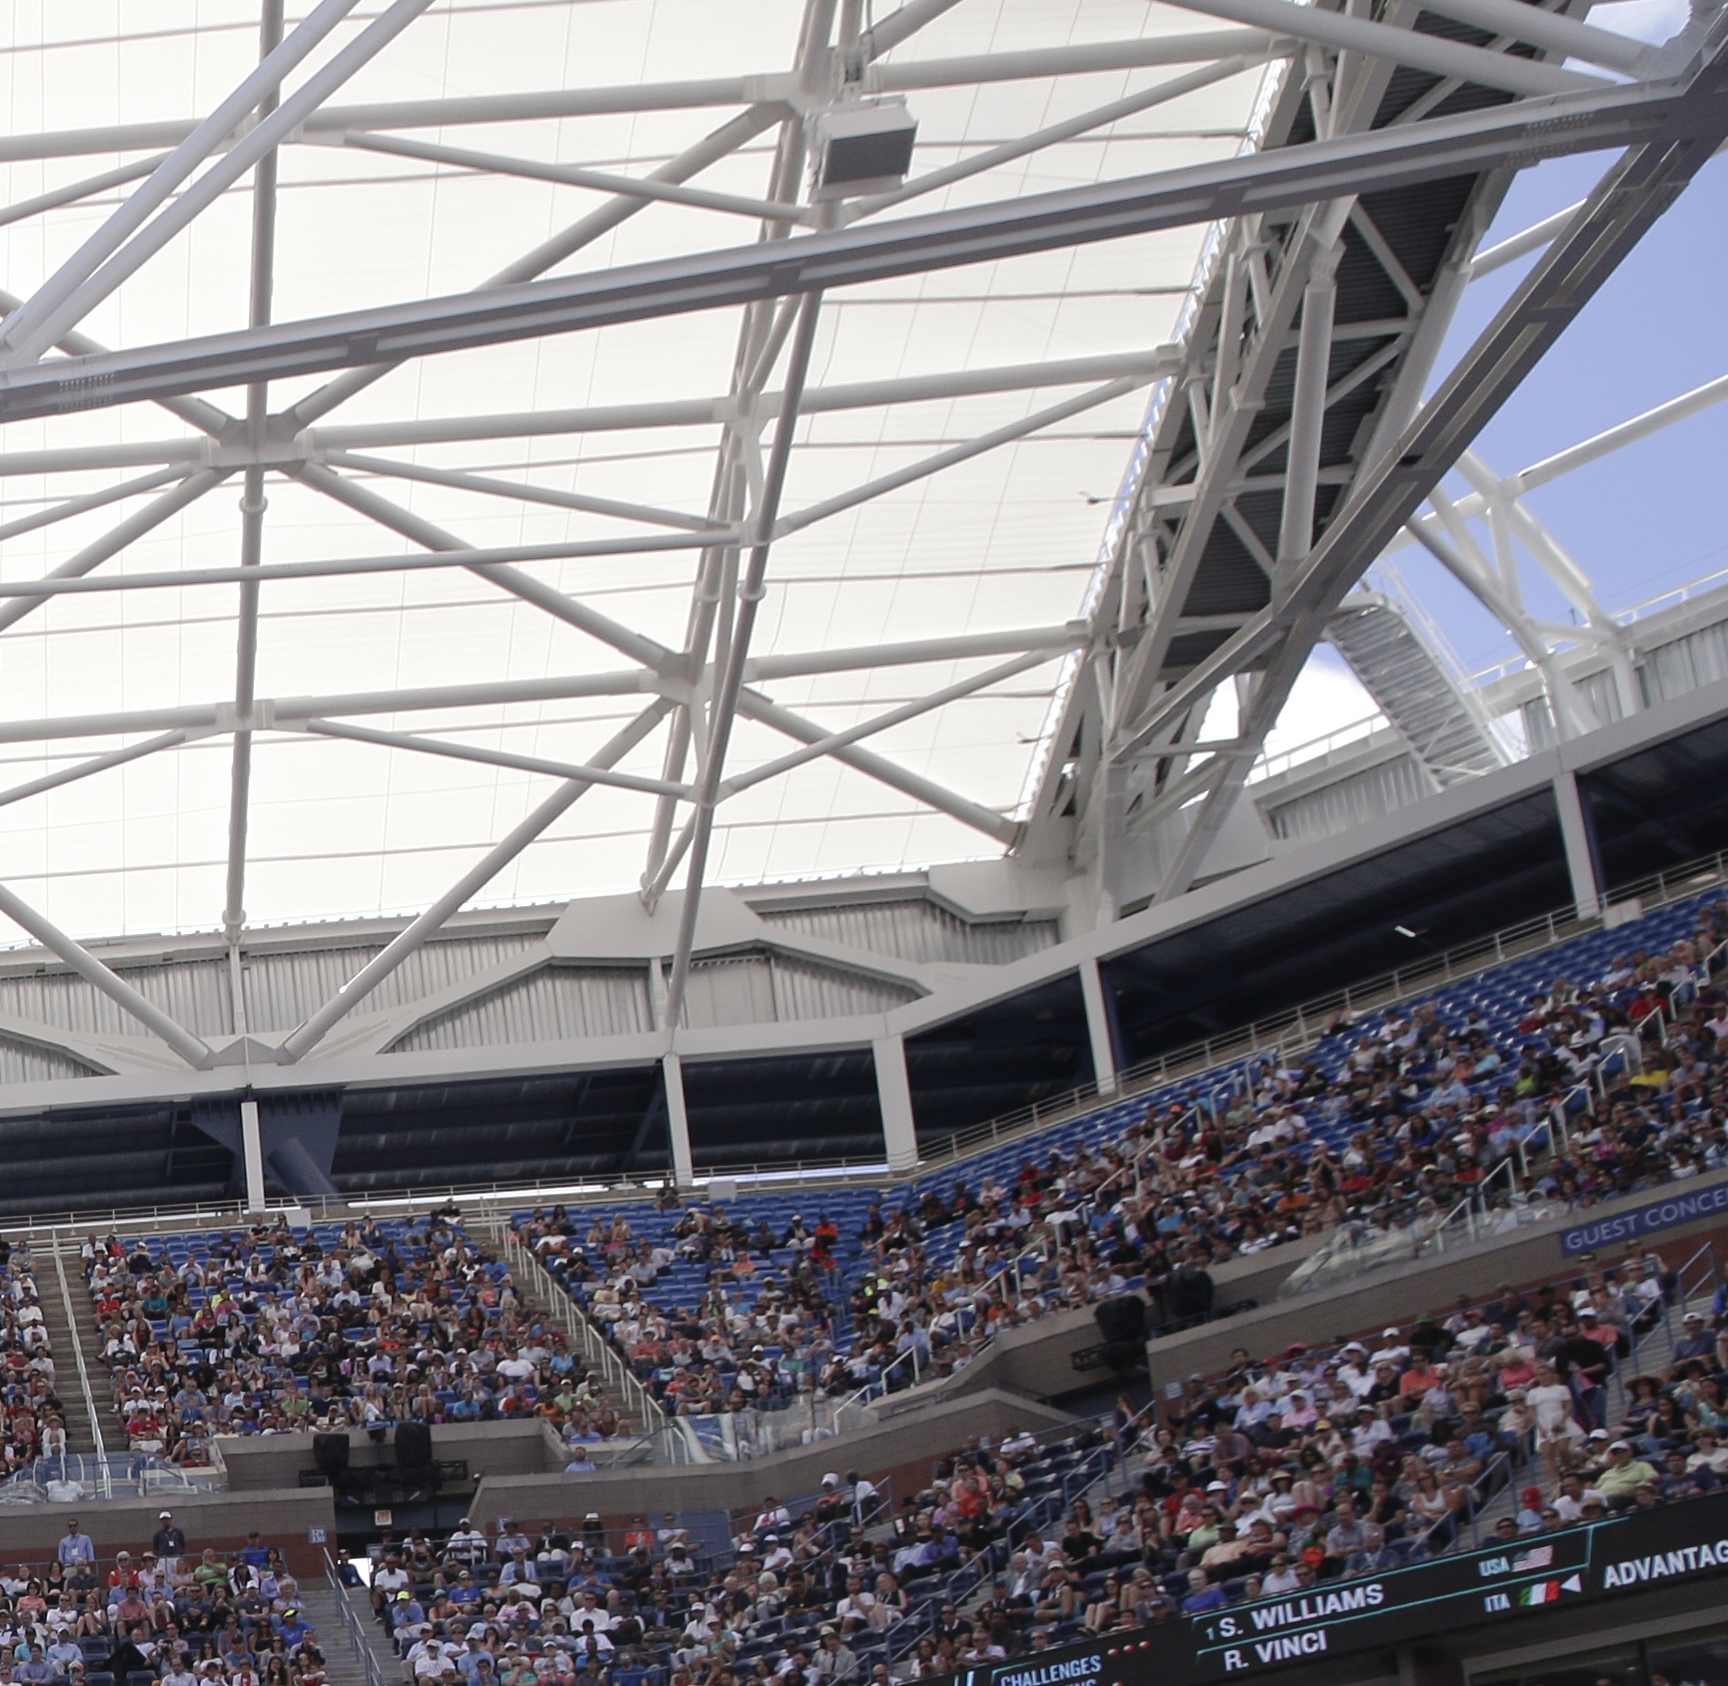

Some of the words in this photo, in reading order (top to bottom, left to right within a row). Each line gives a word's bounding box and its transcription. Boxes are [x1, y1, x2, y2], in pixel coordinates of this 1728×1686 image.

[1566, 1213, 1638, 1248] GUEST
[1645, 1190, 1728, 1226] CONCE
[1478, 1556, 1511, 1577] USA
[1206, 1627, 1215, 1641] 1
[1219, 1617, 1243, 1638] S.
[1251, 1584, 1384, 1630] WILLIAMS
[1484, 1593, 1511, 1613] ITA
[1223, 1650, 1249, 1672] R.
[1255, 1630, 1328, 1664] VINCI
